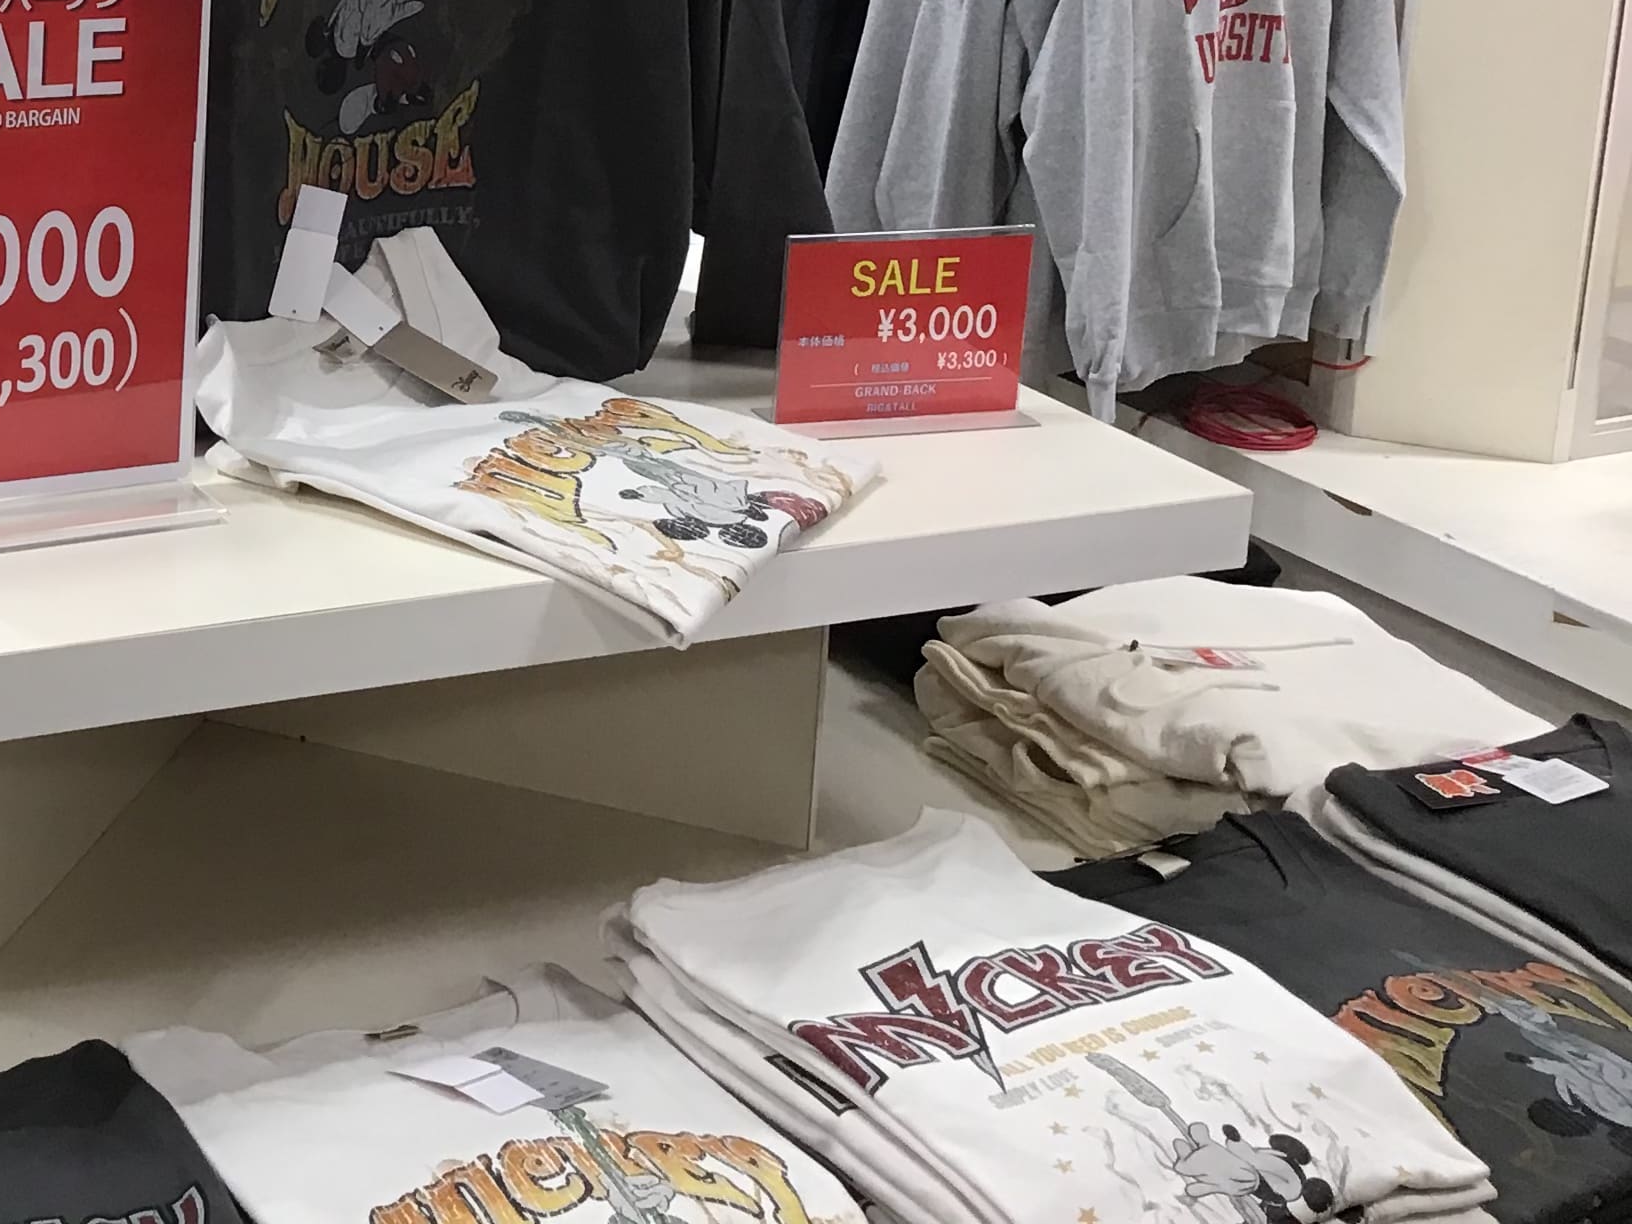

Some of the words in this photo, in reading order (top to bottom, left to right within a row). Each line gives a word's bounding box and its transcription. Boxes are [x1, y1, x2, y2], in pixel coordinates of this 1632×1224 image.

[5, 107, 81, 128] BARGAIN
[851, 257, 960, 297] SALE
[877, 304, 997, 343] ¥3,000
[937, 349, 997, 370] ¥3,300
[788, 922, 1234, 1095] MICKEY
[999, 1057, 1029, 1077] ALL
[1027, 1042, 1067, 1071] YOU
[1065, 1031, 1106, 1054] NEED
[1108, 1026, 1127, 1044] IS
[1046, 1068, 1080, 1095] LOVE
